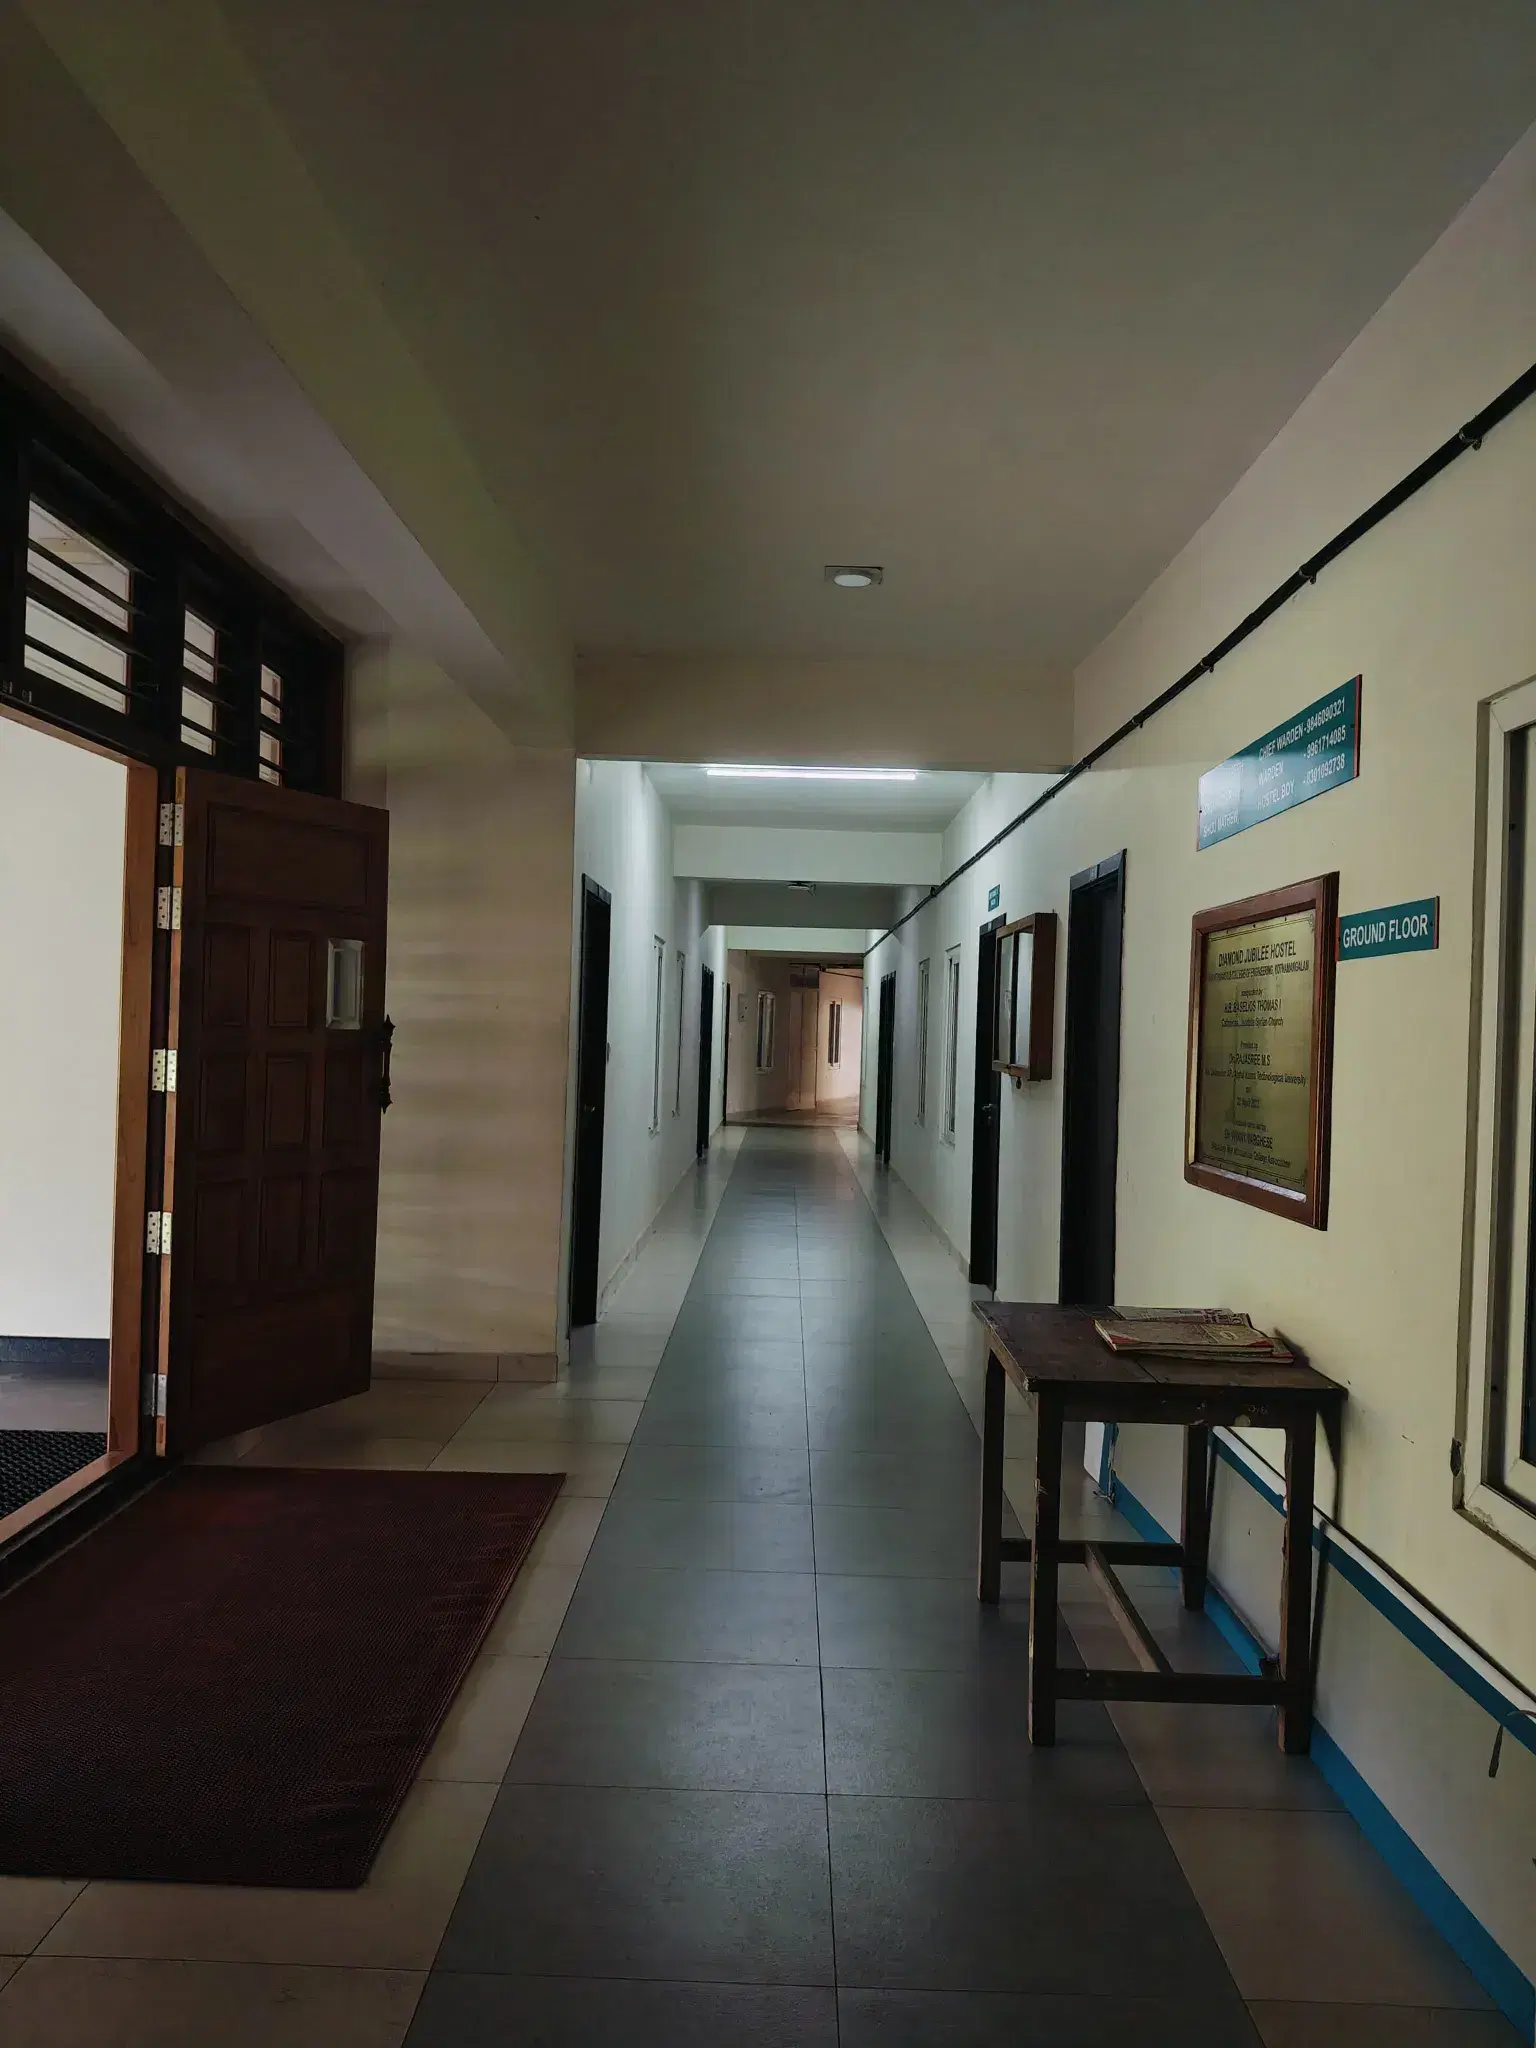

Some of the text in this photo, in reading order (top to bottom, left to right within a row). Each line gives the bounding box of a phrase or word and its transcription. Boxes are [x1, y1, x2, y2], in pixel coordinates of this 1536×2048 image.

[1259, 739, 1276, 761] CHIEF
[1277, 723, 1304, 751] WARDEN
[1258, 761, 1284, 786] WARDEN
[1281, 778, 1295, 801] BOY
[1343, 914, 1428, 949] GROUND FLOOR
[1218, 940, 1297, 968] DIAMOND JUBILEE HOSTEL
[1257, 999, 1279, 1012] THOMAS
